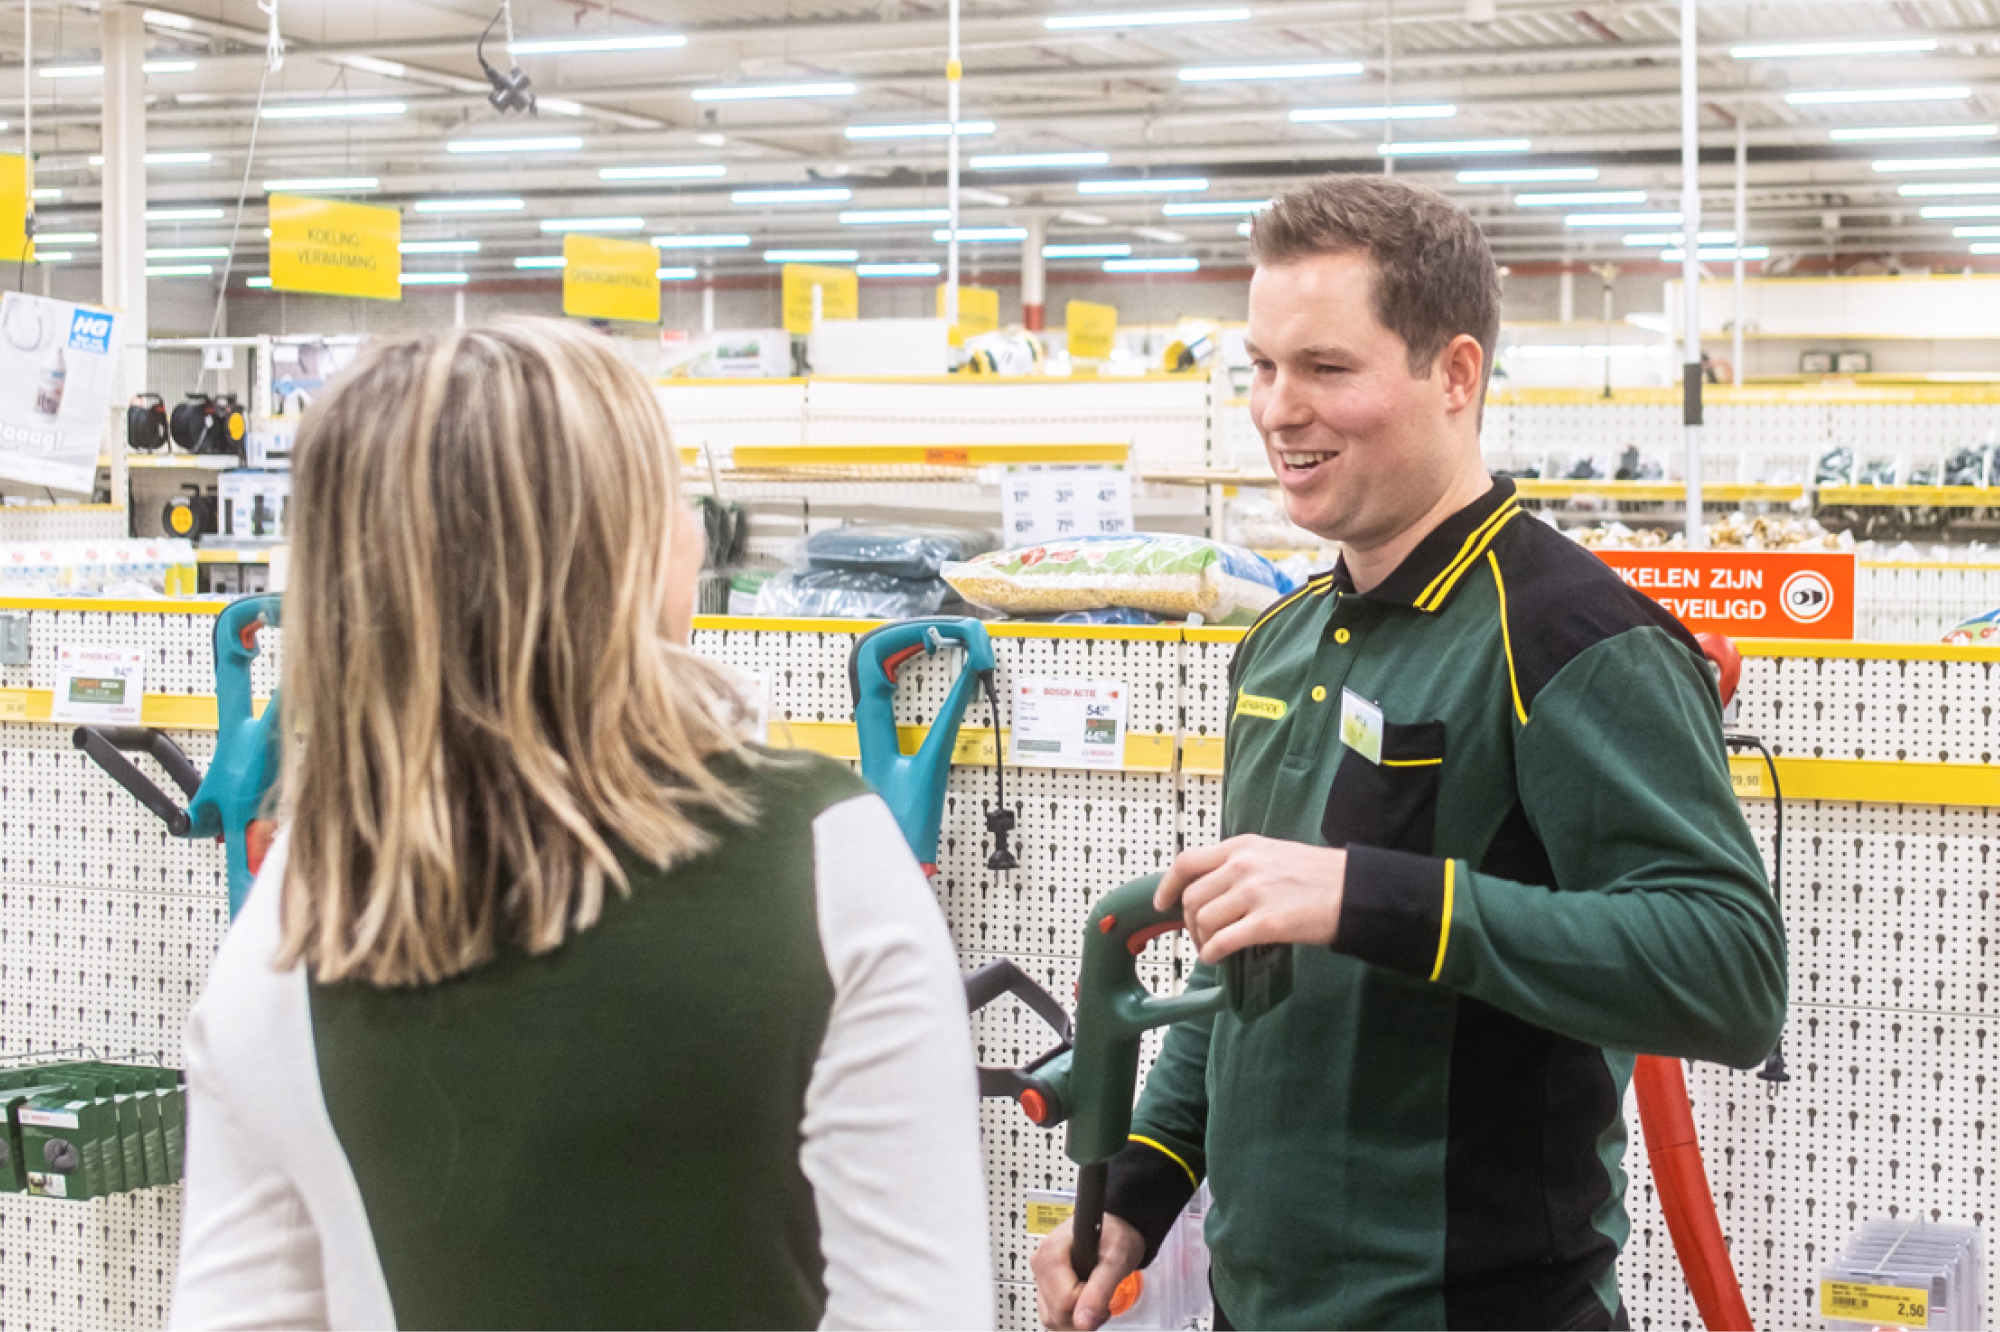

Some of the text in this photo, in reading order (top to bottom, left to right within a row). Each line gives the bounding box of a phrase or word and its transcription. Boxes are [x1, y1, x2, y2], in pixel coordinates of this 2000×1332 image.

[298, 248, 377, 272] VERWARMING
[74, 316, 108, 337] HG
[0, 419, 63, 451] aaag!
[1611, 567, 1763, 589] IKELEN ZIJN
[1656, 597, 1767, 620] EVEILIGD
[1043, 687, 1072, 697] BOSCH
[1897, 1302, 1925, 1318] 2,50
